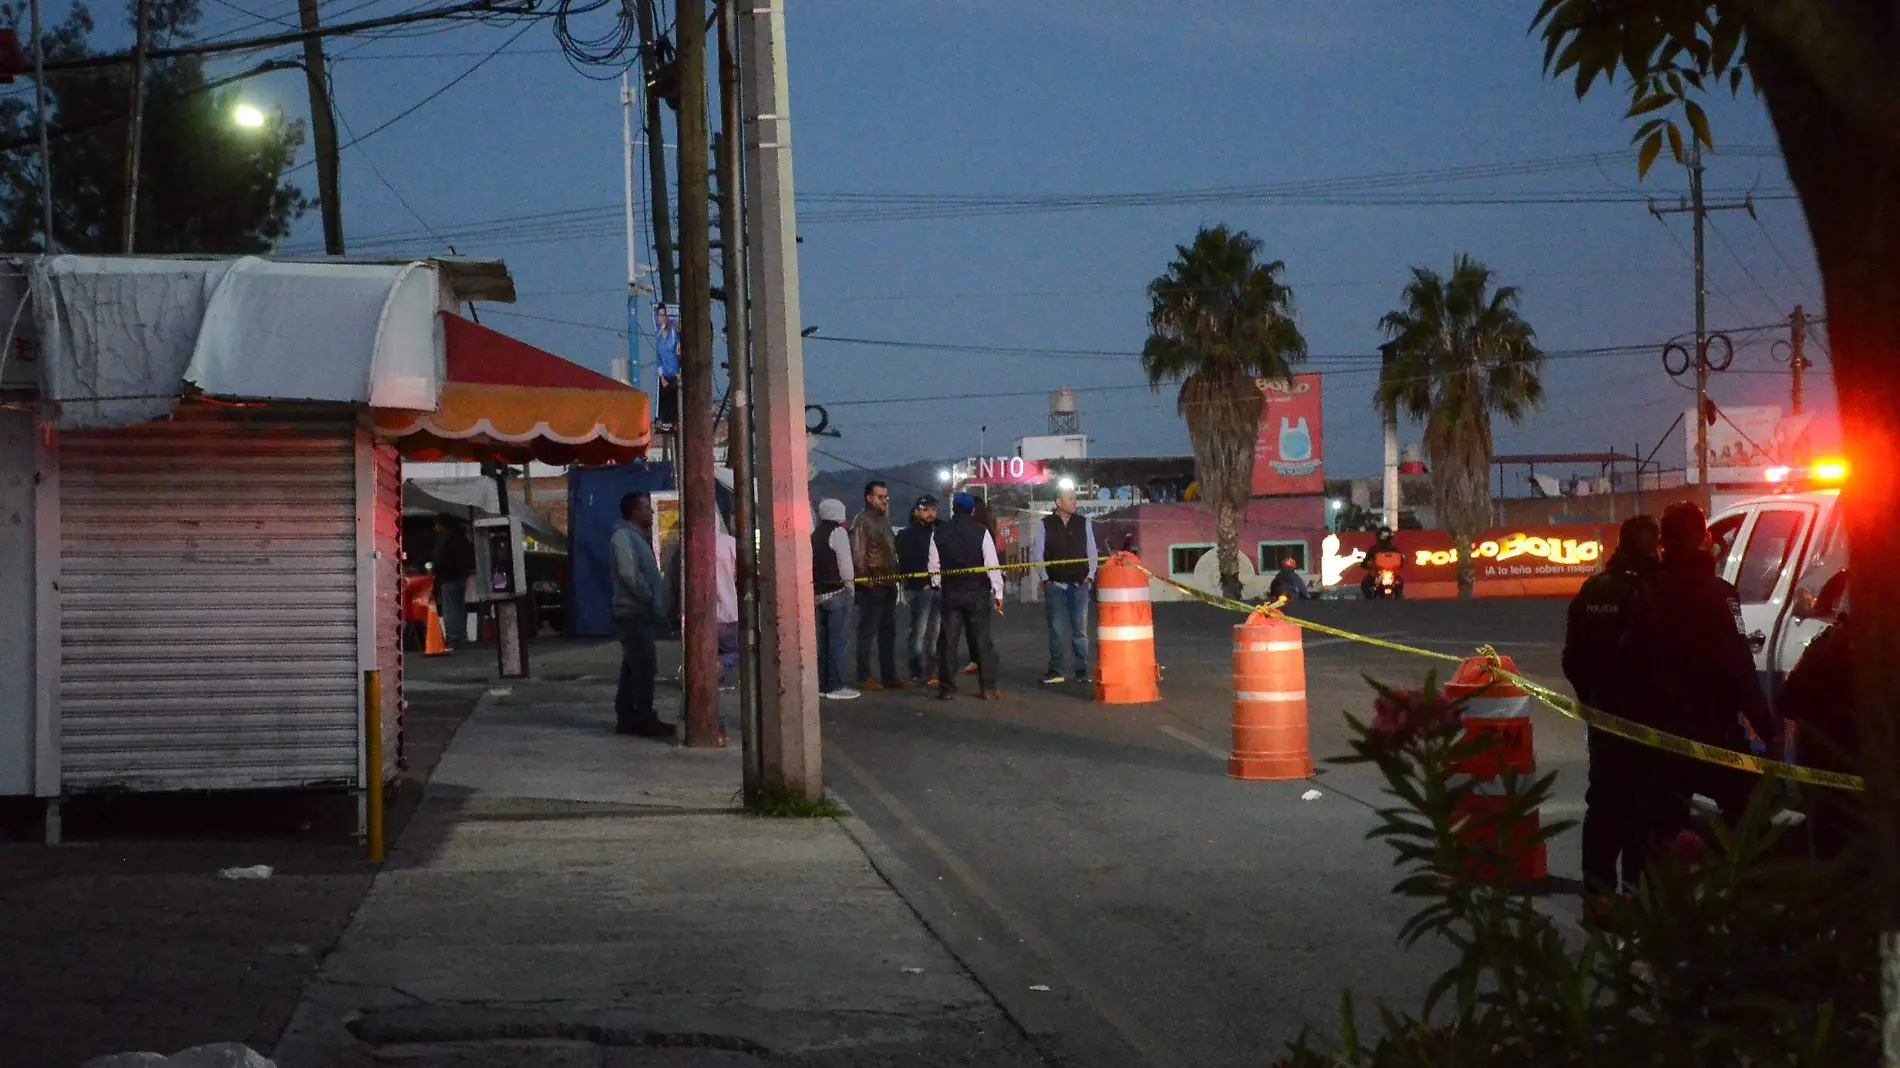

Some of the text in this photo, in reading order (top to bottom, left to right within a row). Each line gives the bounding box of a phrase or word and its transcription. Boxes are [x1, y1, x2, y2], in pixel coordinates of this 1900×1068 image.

[1498, 565, 1508, 575] la
[1510, 564, 1532, 575] leña
[1535, 563, 1565, 574] saben
